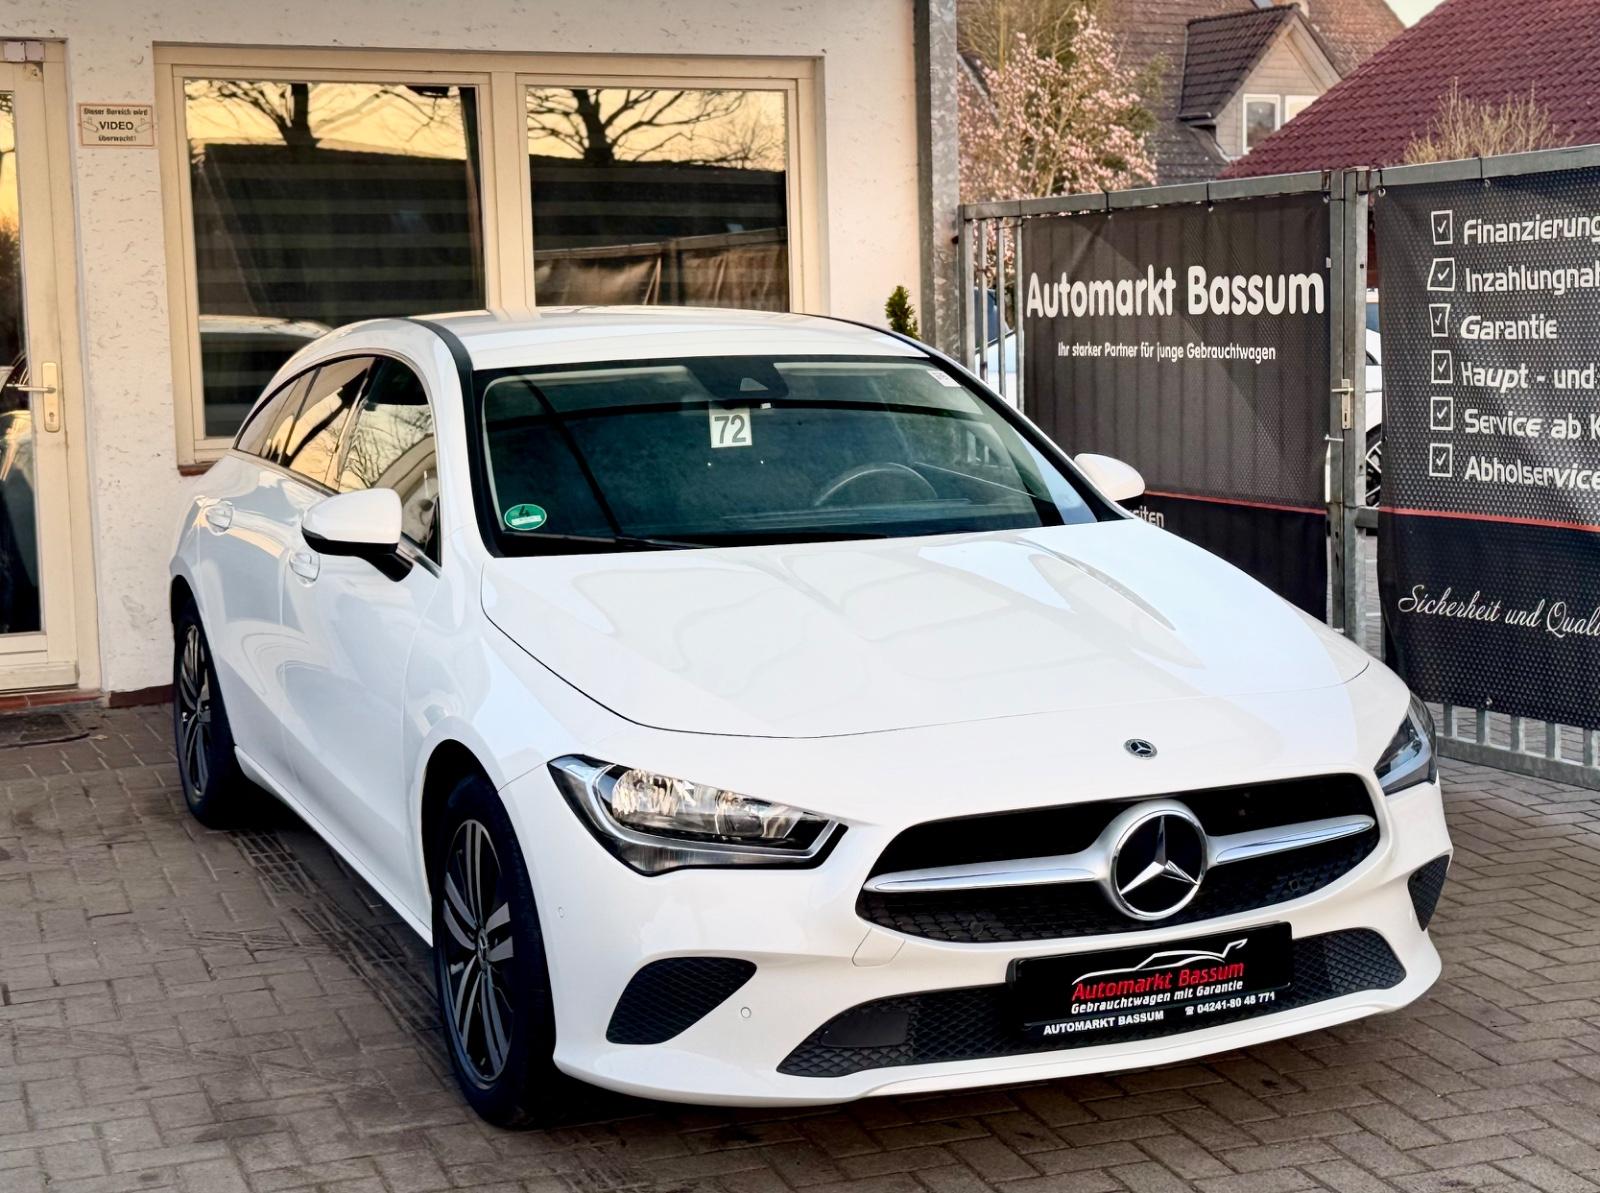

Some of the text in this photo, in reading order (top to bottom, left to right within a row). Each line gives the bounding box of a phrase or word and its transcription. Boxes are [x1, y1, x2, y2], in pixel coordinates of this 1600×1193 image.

[99, 121, 134, 130] VIDEO
[1463, 214, 1600, 245] Finanzierung
[1026, 264, 1325, 317] Automarkt Bassum
[1460, 313, 1558, 340] Garantie
[1057, 342, 1276, 364] Ihr starker Partner für junge Gebrauchtwagen
[1460, 362, 1529, 393] Haupt
[1553, 362, 1595, 390] und
[714, 414, 747, 444] 72
[1464, 408, 1544, 438] Service
[1550, 412, 1582, 440] ab
[1463, 455, 1600, 490] Abholservice
[1397, 584, 1501, 622] Sicherheit
[1504, 599, 1546, 628] und
[1071, 961, 1245, 1001] Automarkt Bassum
[1043, 991, 1276, 1036] AUTOMARKT BASSUM 04241-80 48 771
[1071, 980, 1243, 1015] Gebrauchtwagen mit Garantie
